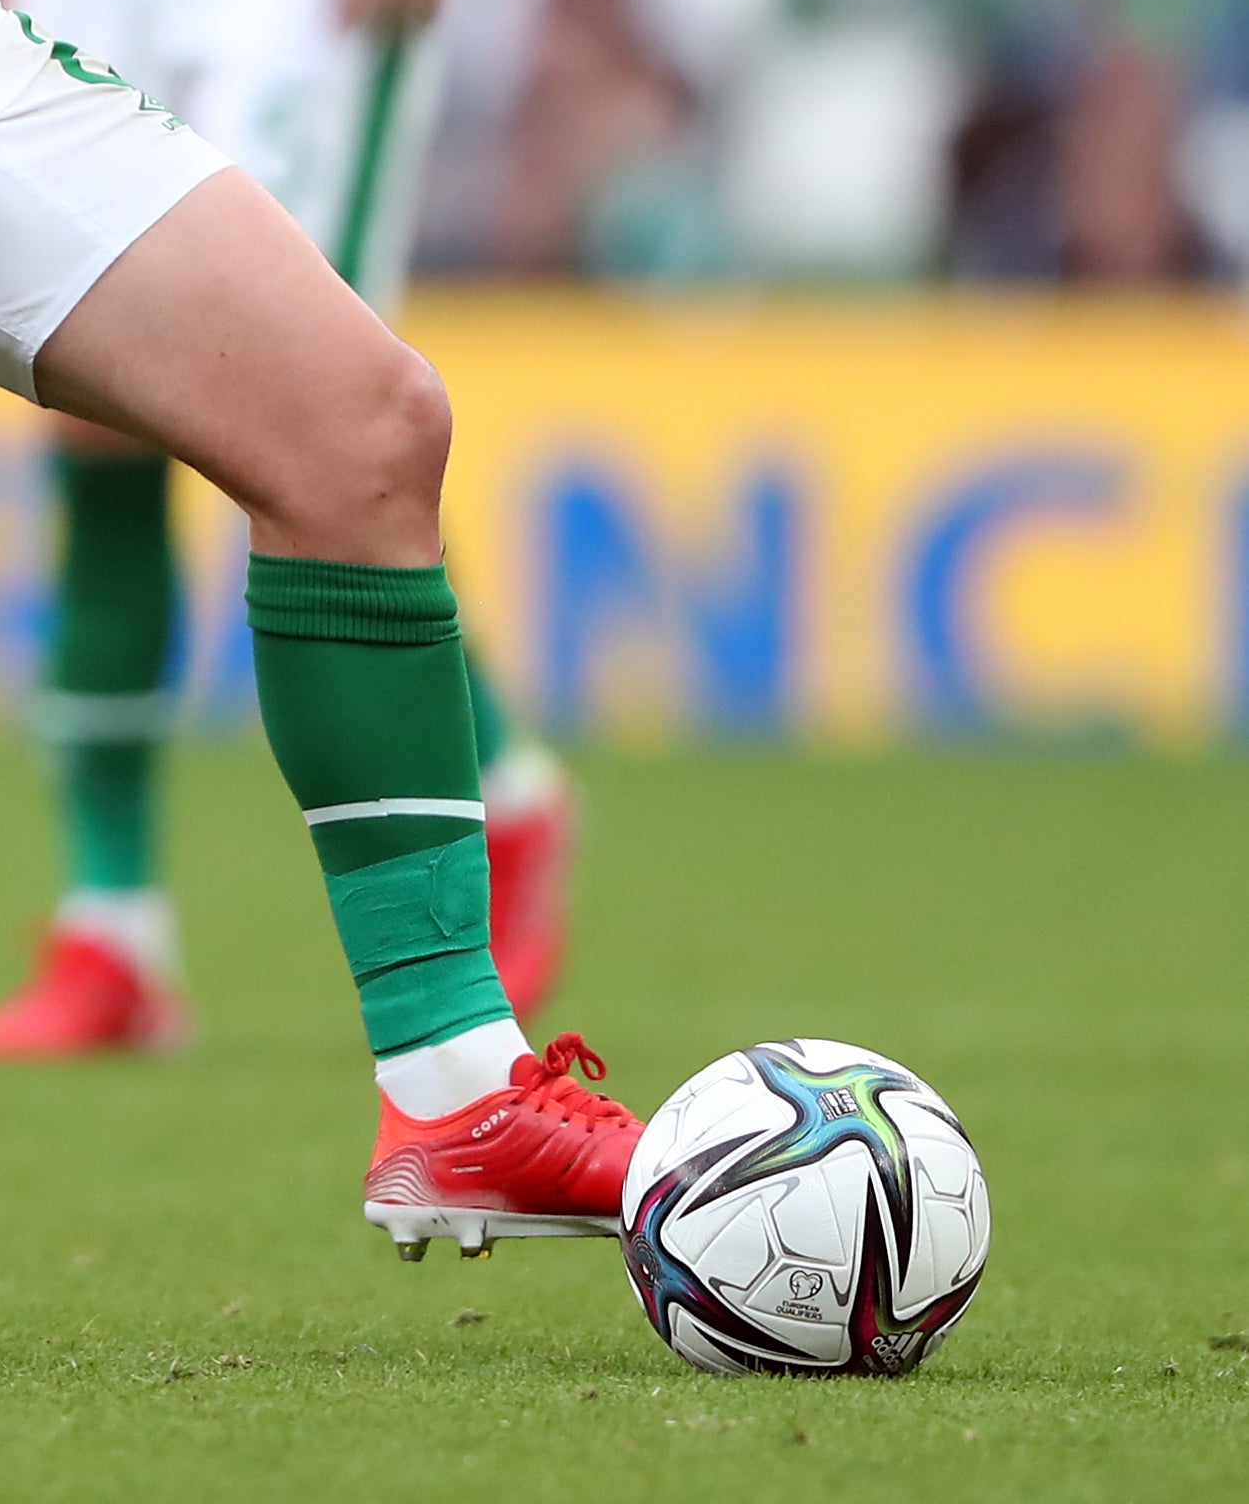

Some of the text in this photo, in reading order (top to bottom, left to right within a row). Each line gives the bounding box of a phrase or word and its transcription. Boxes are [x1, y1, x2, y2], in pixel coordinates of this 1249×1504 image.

[471, 1108, 509, 1138] COPA
[775, 1306, 823, 1321] QUALIFIERS
[782, 1300, 821, 1313] EUROPEAN
[871, 1336, 902, 1372] adida
